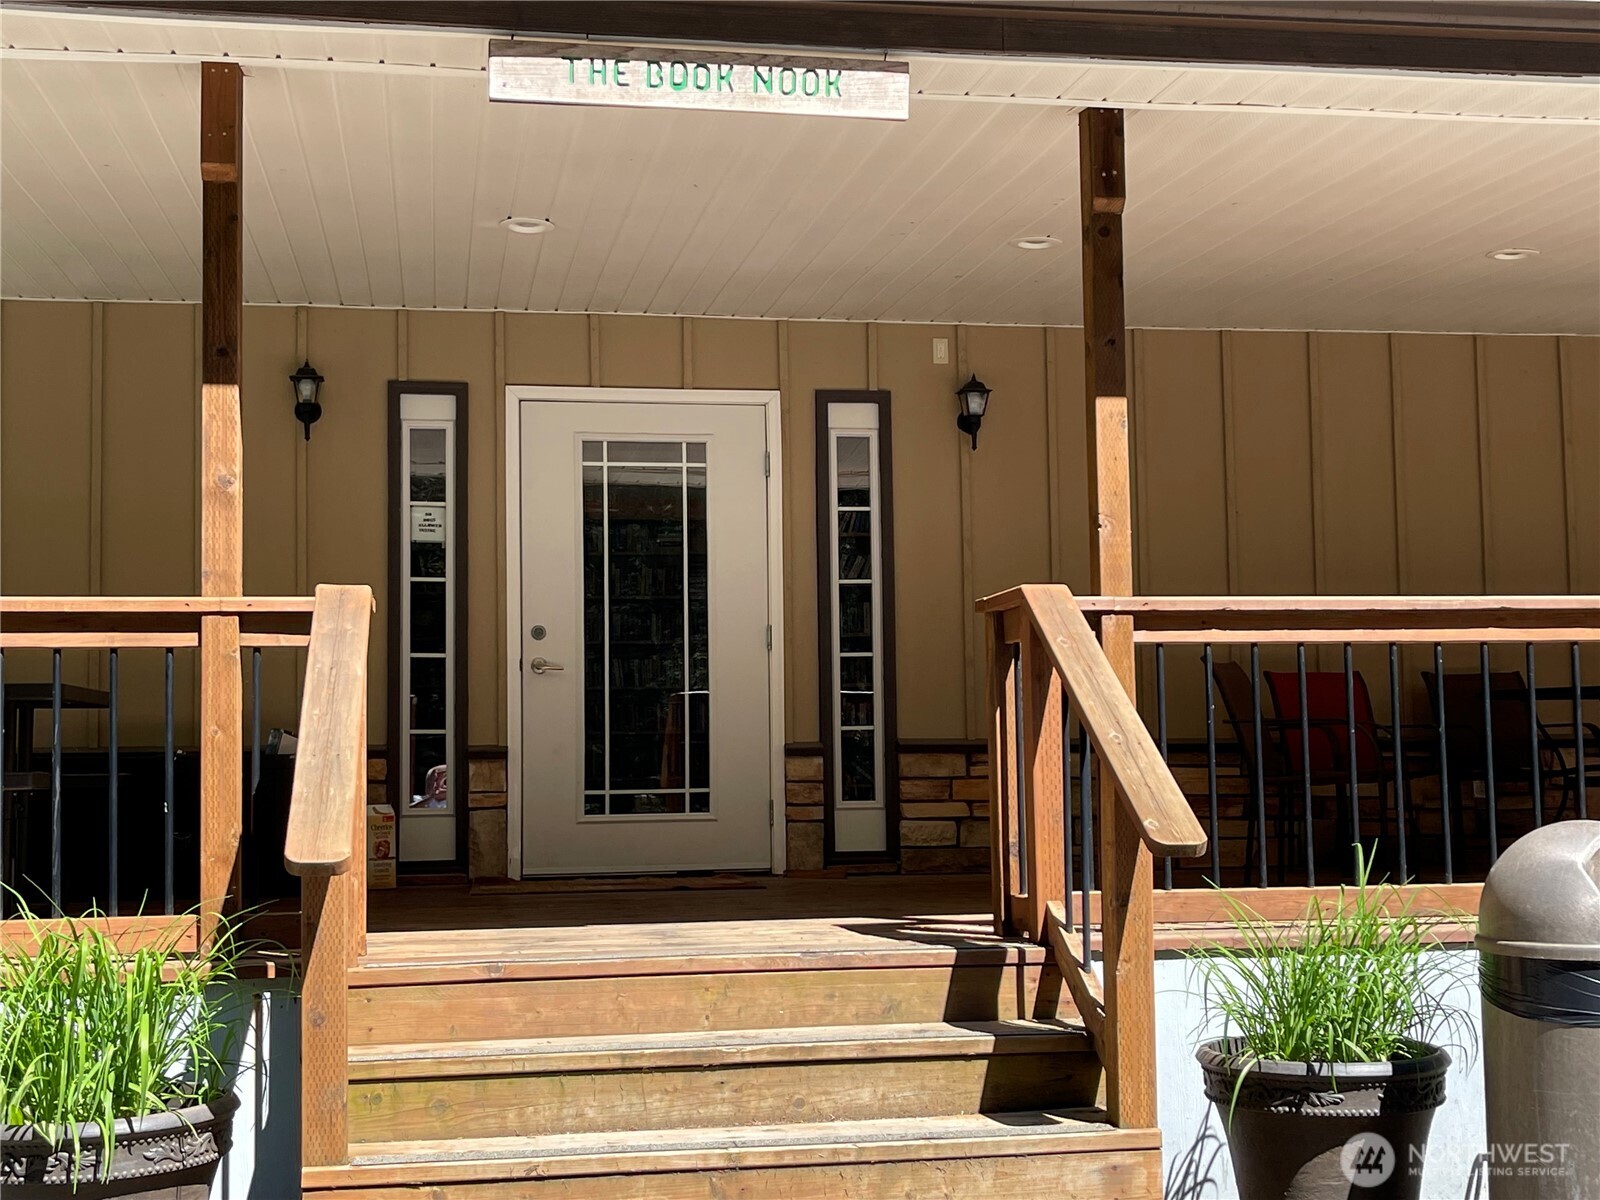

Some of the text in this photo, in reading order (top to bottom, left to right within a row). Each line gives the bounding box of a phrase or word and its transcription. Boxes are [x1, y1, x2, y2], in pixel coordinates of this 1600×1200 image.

[560, 56, 842, 97] THE BOOK NOOK
